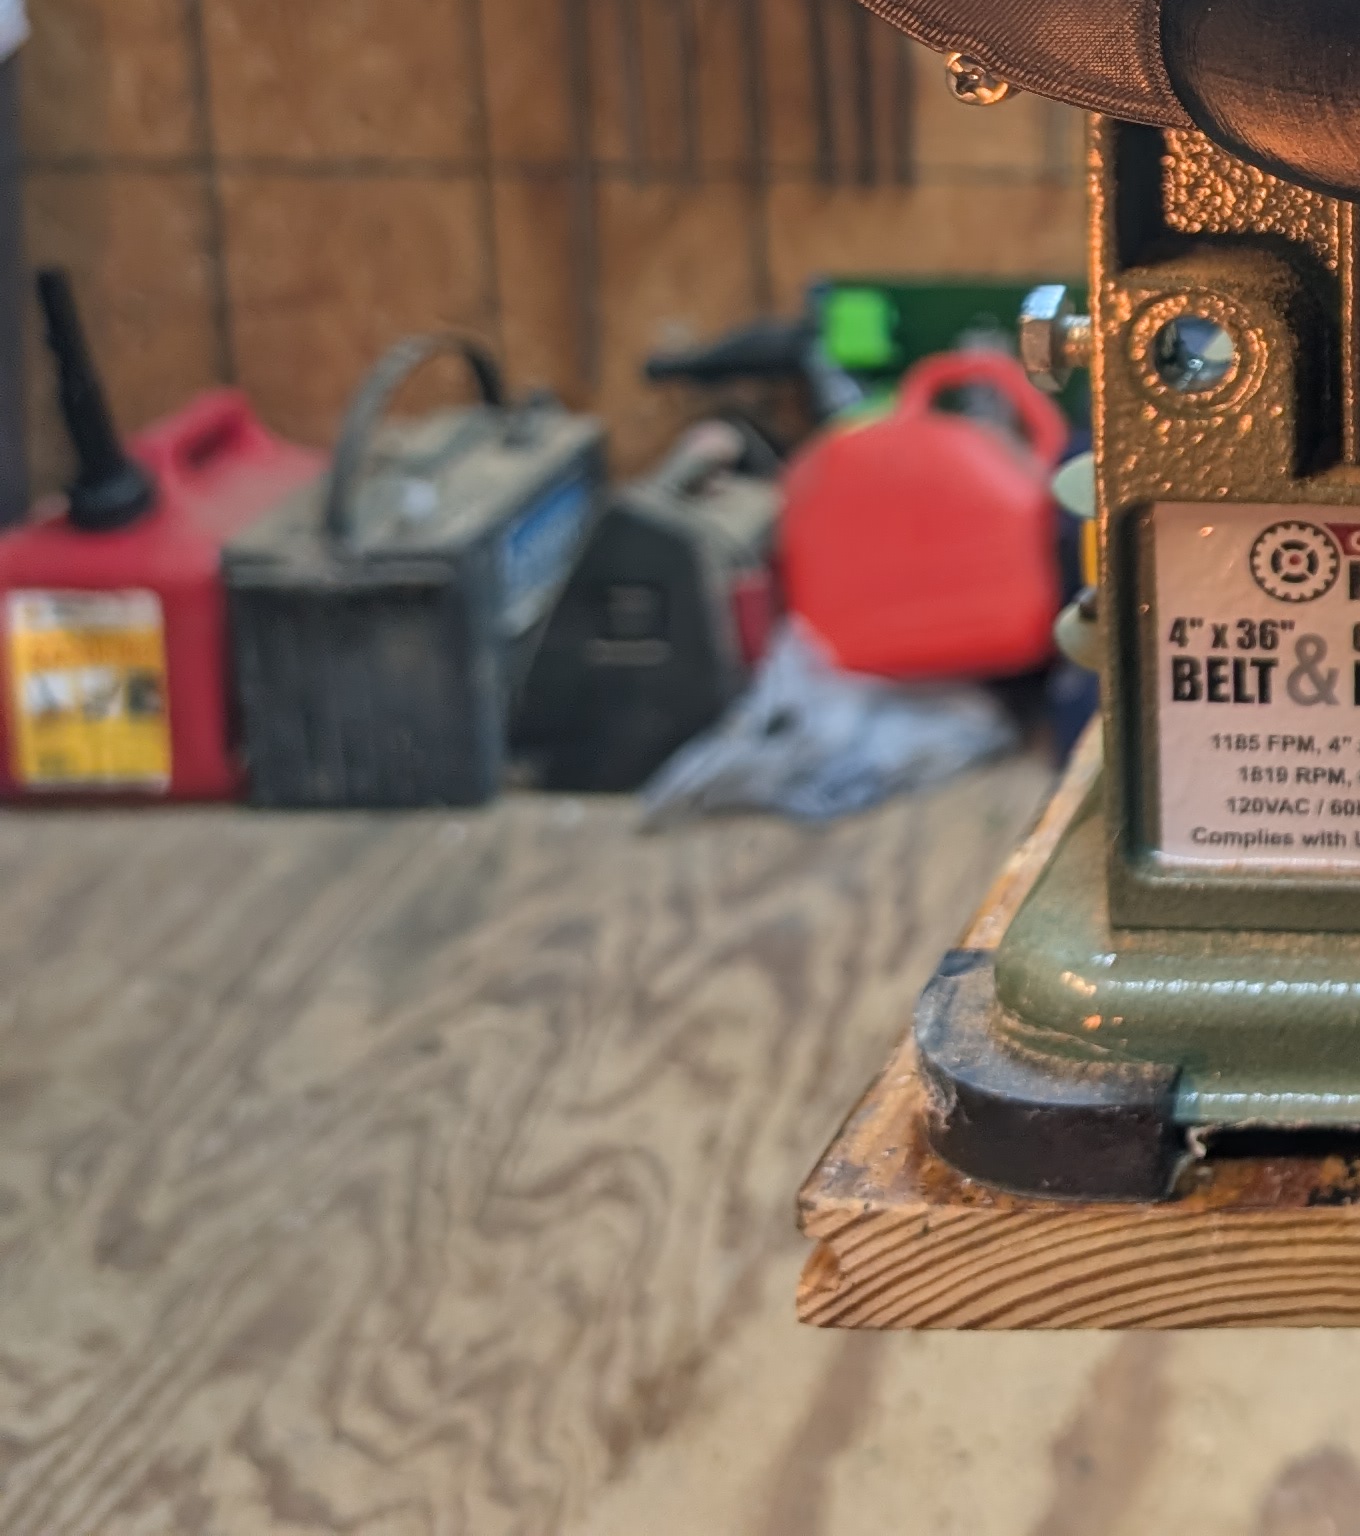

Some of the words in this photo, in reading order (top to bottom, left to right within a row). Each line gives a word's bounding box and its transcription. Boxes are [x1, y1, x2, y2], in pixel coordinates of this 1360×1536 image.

[1211, 622, 1229, 649] x
[1171, 655, 1280, 705] BELT
[1286, 632, 1341, 707] &
[1266, 734, 1322, 755] FPM,
[1295, 766, 1352, 788] RPM,
[1226, 796, 1311, 816] 120VAC
[1190, 825, 1295, 849] Complies
[1301, 827, 1348, 848] with
